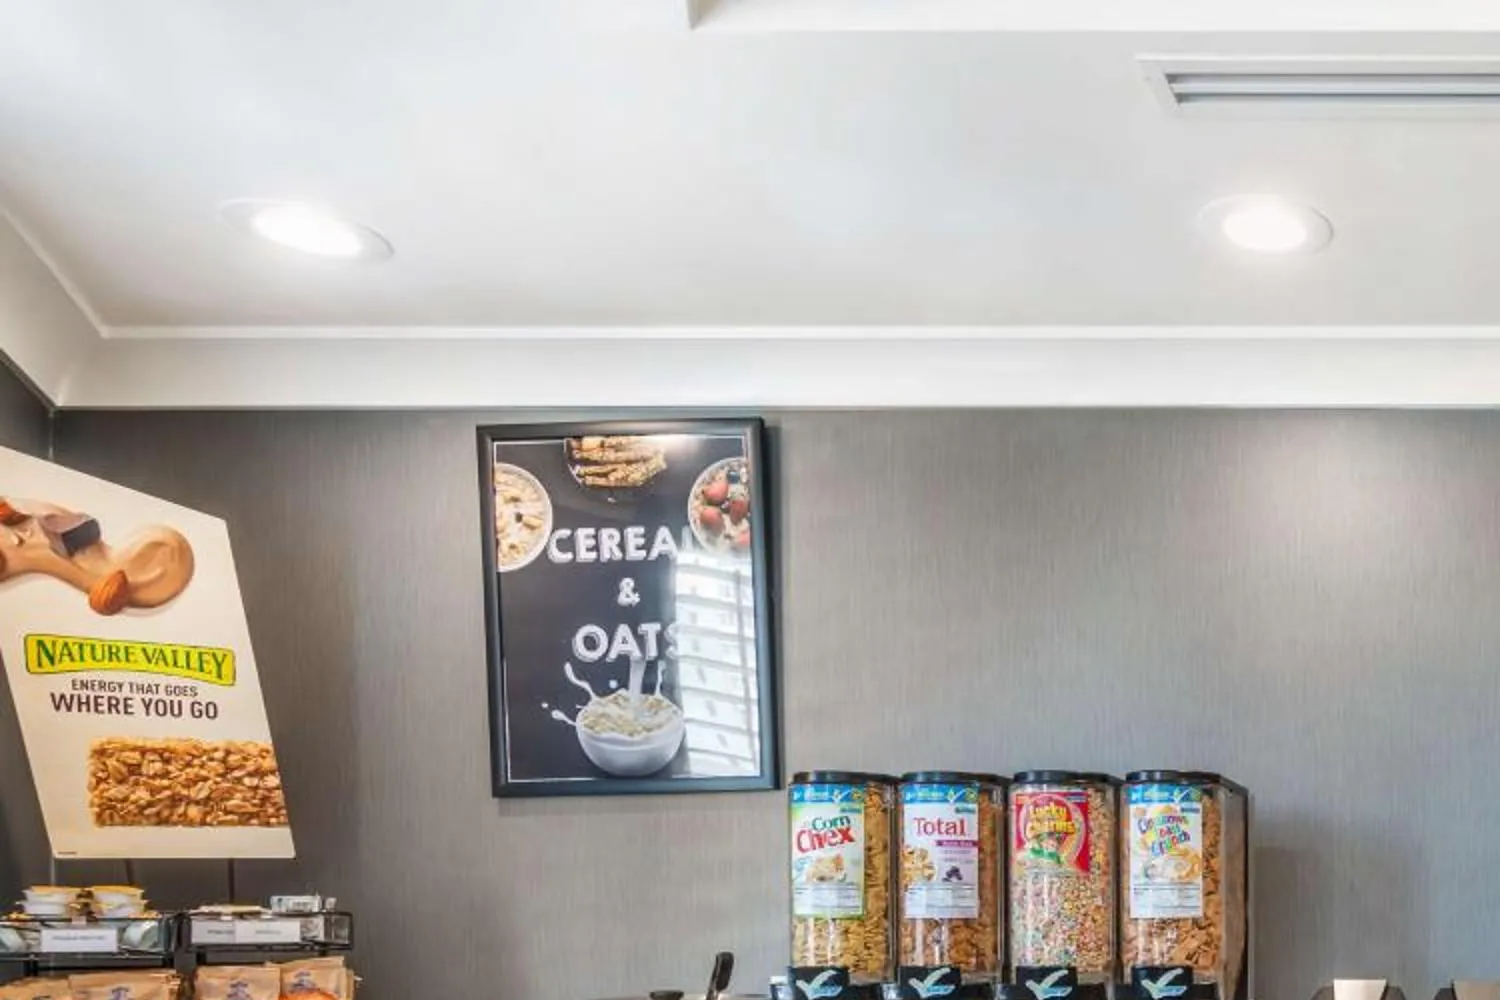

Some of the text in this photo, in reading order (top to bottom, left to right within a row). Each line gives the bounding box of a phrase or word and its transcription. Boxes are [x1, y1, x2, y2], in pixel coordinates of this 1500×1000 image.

[617, 577, 640, 606] &
[36, 639, 228, 681] NATURE VALLEY
[71, 678, 199, 698] ENERGY THAT GOES
[51, 692, 218, 720] WHERE YOU GO
[812, 815, 851, 831] Corn
[914, 817, 967, 837] Total
[796, 827, 855, 854] Chex
